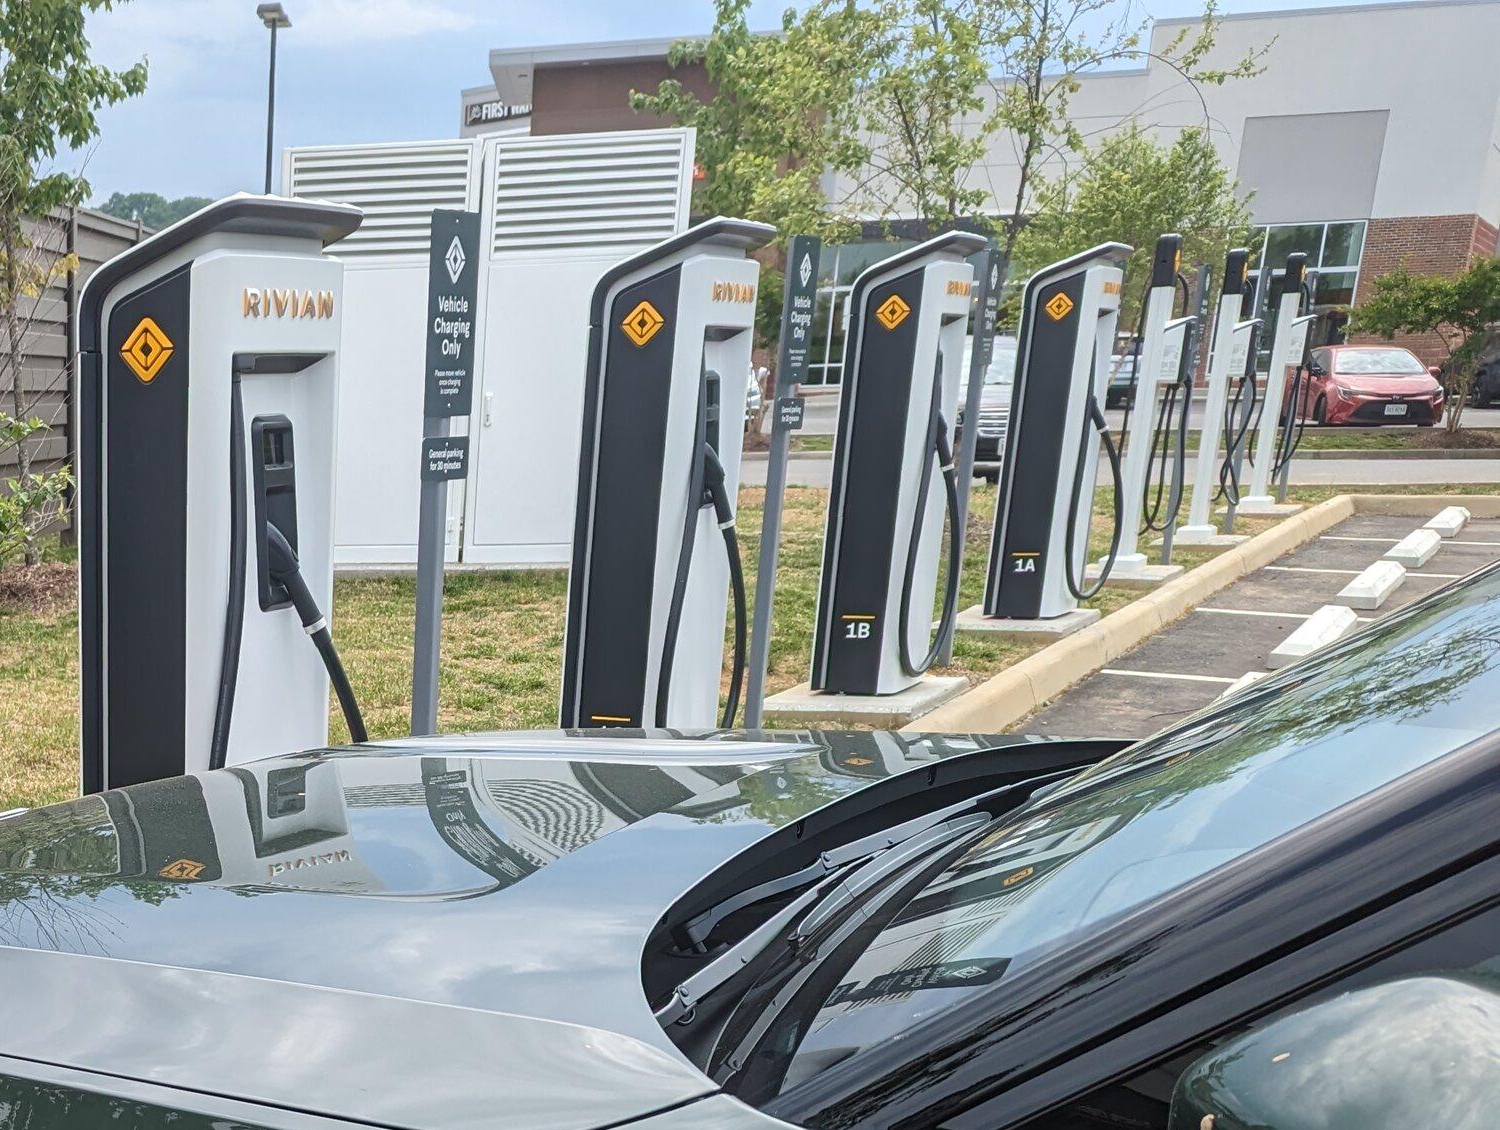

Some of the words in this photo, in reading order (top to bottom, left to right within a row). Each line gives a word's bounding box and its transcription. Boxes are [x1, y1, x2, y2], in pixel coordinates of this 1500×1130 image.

[242, 287, 334, 319] RIVIAN
[438, 295, 469, 313] Vehicle
[434, 316, 471, 339] Charging
[441, 338, 462, 360] Only
[1013, 558, 1036, 573] 1A
[845, 622, 871, 639] 1B
